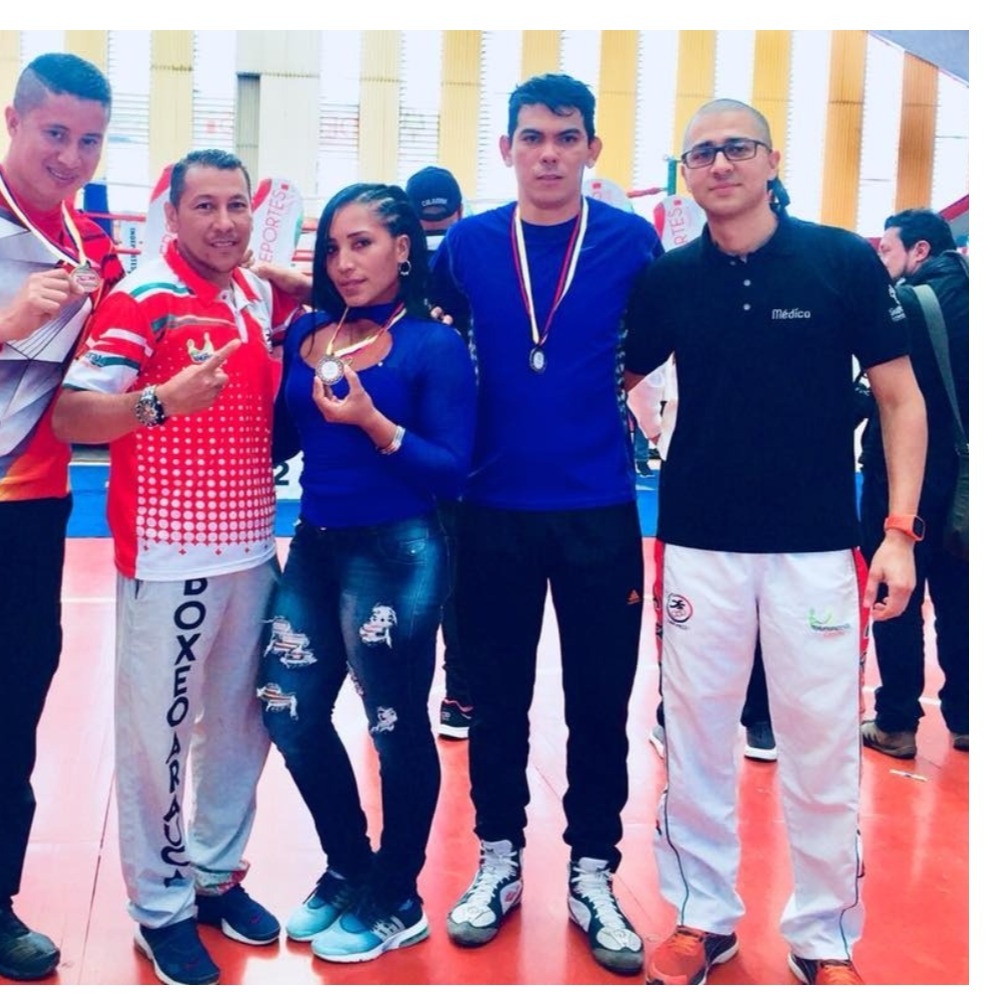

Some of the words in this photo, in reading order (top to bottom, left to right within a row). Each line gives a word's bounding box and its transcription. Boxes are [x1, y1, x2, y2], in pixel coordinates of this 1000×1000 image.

[260, 188, 286, 262] EPORTES
[771, 308, 811, 320] Médico
[273, 461, 290, 486] 2
[166, 578, 208, 728] BOXEO
